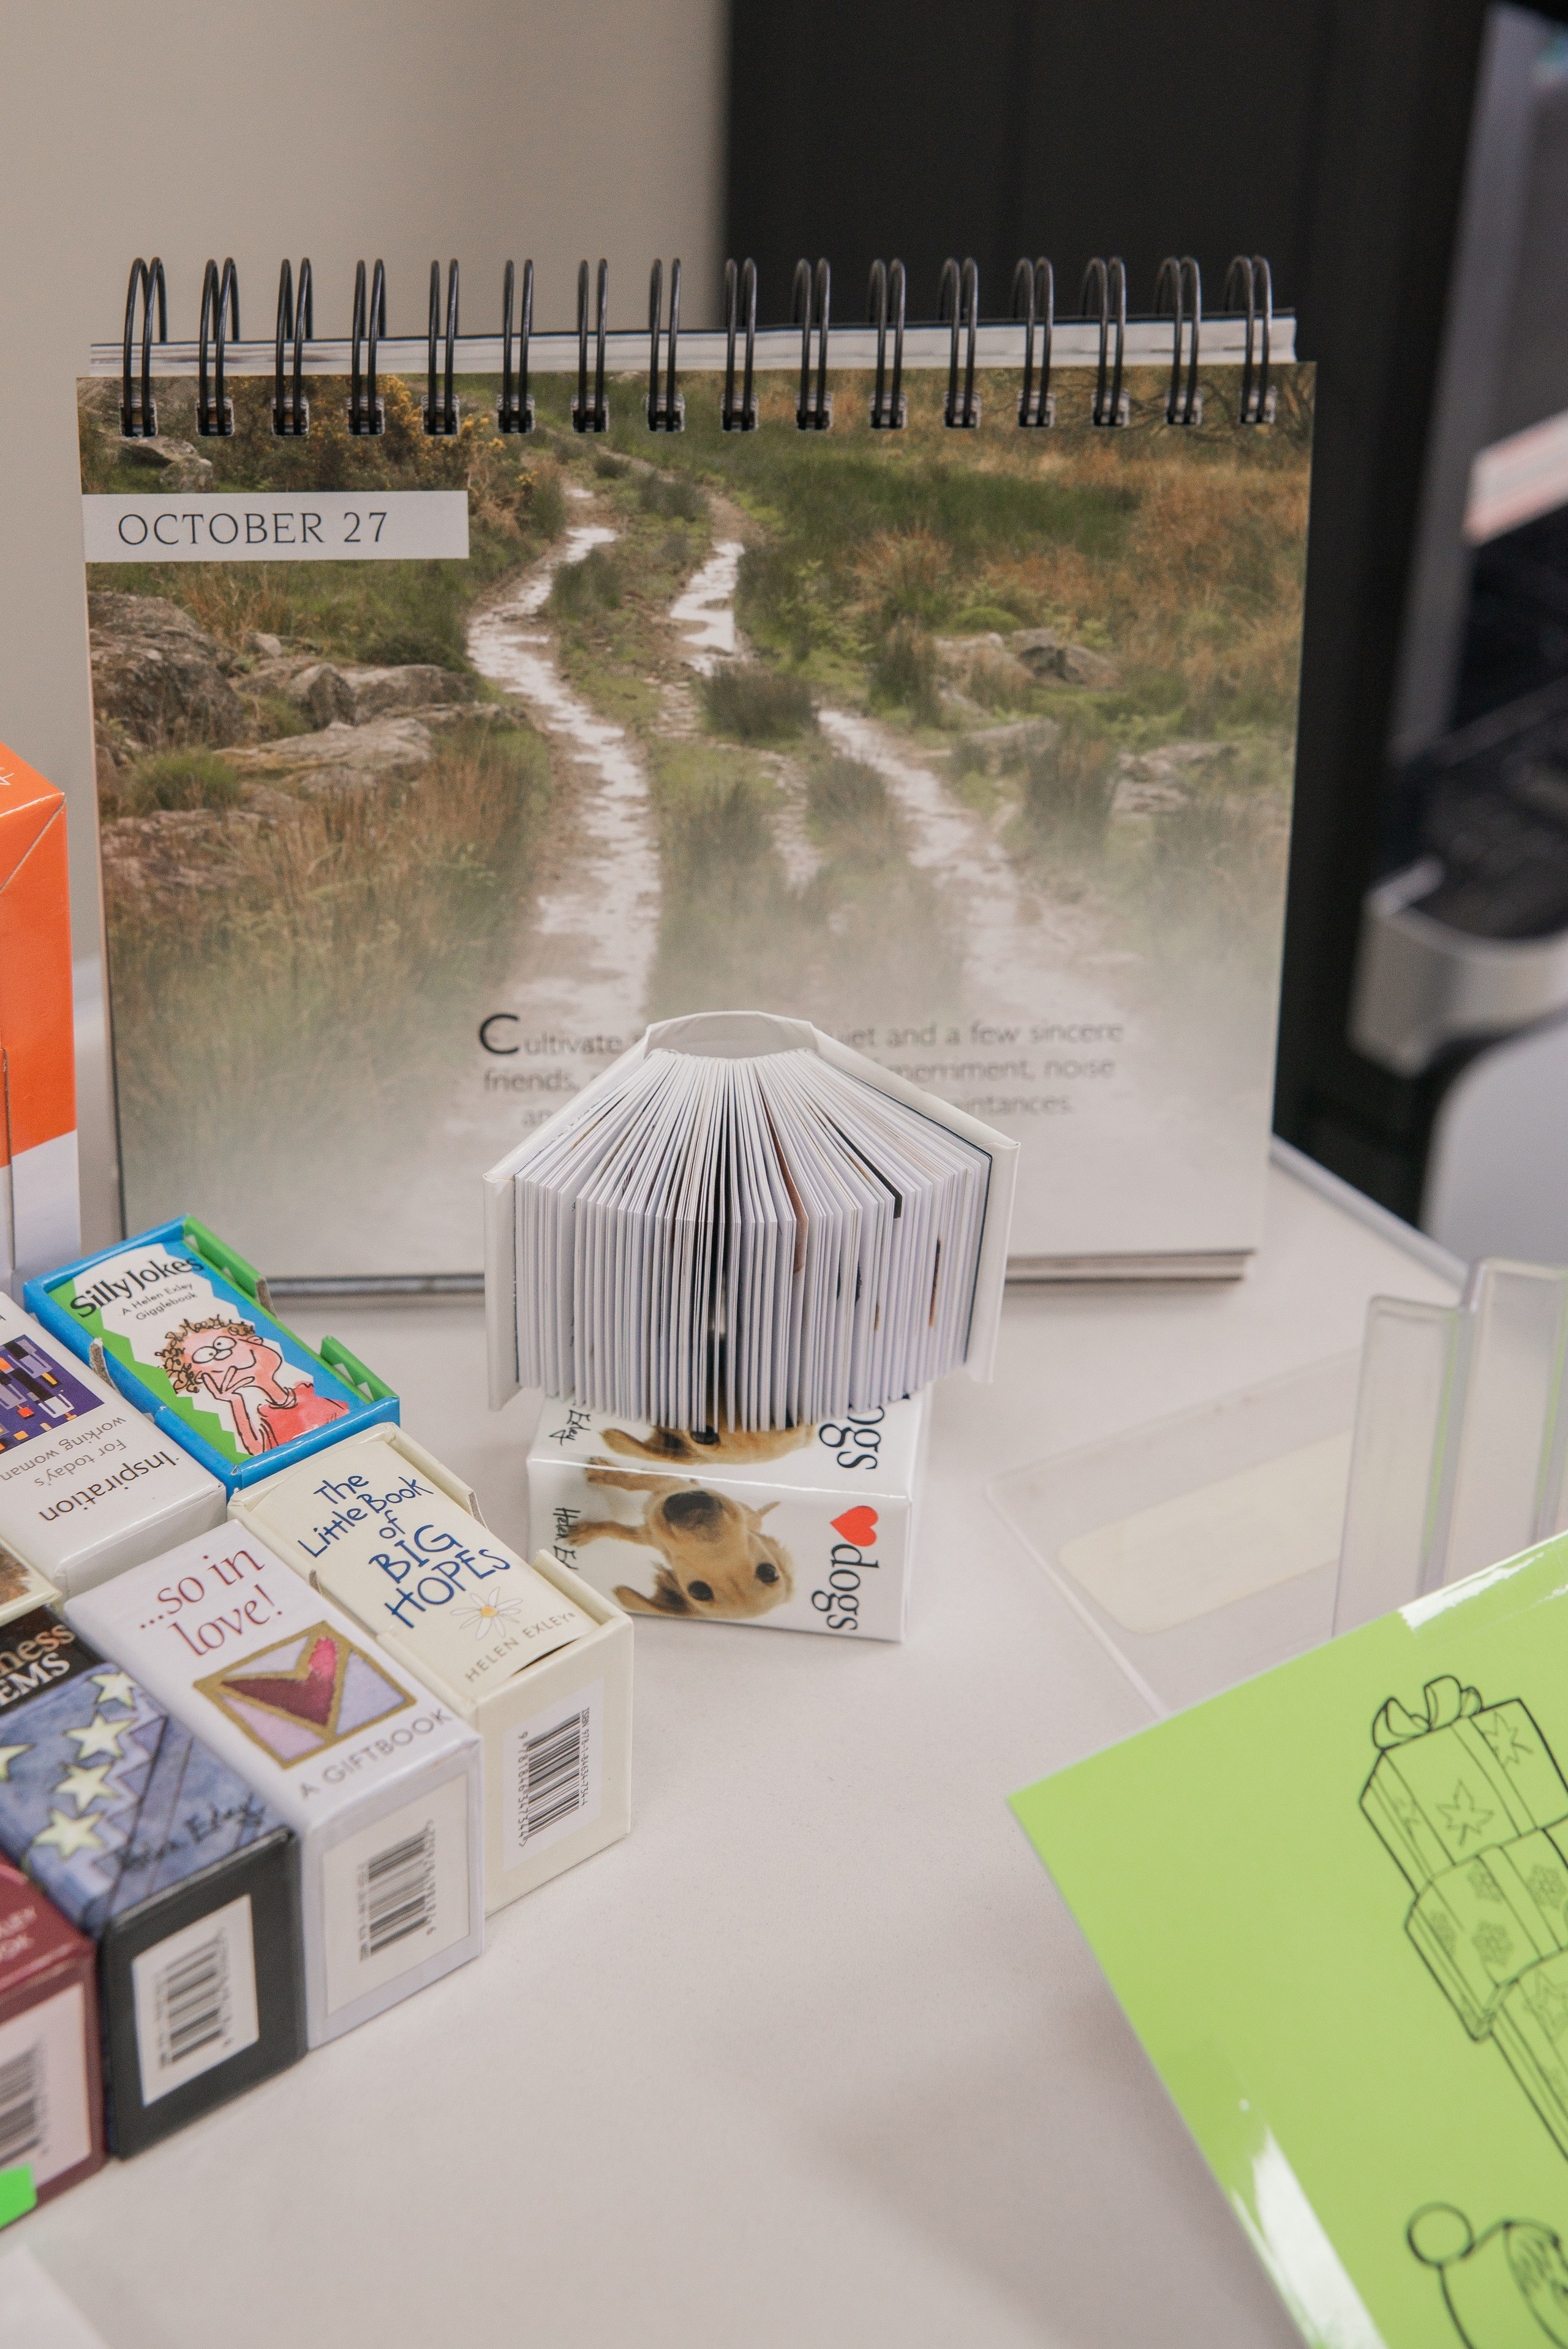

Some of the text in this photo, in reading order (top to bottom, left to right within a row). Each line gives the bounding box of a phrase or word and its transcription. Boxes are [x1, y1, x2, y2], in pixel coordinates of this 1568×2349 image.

[118, 511, 388, 545] OCTOBER 27
[479, 1013, 624, 1055] Cultivate
[887, 1020, 937, 1047] and
[945, 1027, 961, 1046] a
[970, 1019, 1022, 1045] few
[1030, 1020, 1124, 1043] sincere
[1044, 1057, 1116, 1079] noise
[69, 1257, 204, 1319] Silly Jokes
[122, 1283, 193, 1316] A Helen Exley
[136, 1292, 197, 1320] Gigglebook
[1, 1417, 127, 1481] working woman
[819, 1405, 885, 1470] ogs
[34, 1439, 127, 1487] For today's
[39, 1451, 178, 1521] Inspiration
[313, 1474, 369, 1506] The
[298, 1476, 434, 1558] Little Book
[379, 1509, 406, 1540] of
[552, 1507, 581, 1541] Helen
[202, 1549, 265, 1586] in
[368, 1523, 464, 1585] BIG
[384, 1548, 511, 1629] HOPES
[811, 1544, 880, 1631] dogs
[168, 1582, 284, 1656] love!
[464, 1637, 519, 1683] HELEN
[518, 1731, 529, 1740] 9
[581, 1707, 590, 1727] ISBN
[300, 1707, 458, 1801] A GIFTBOOK
